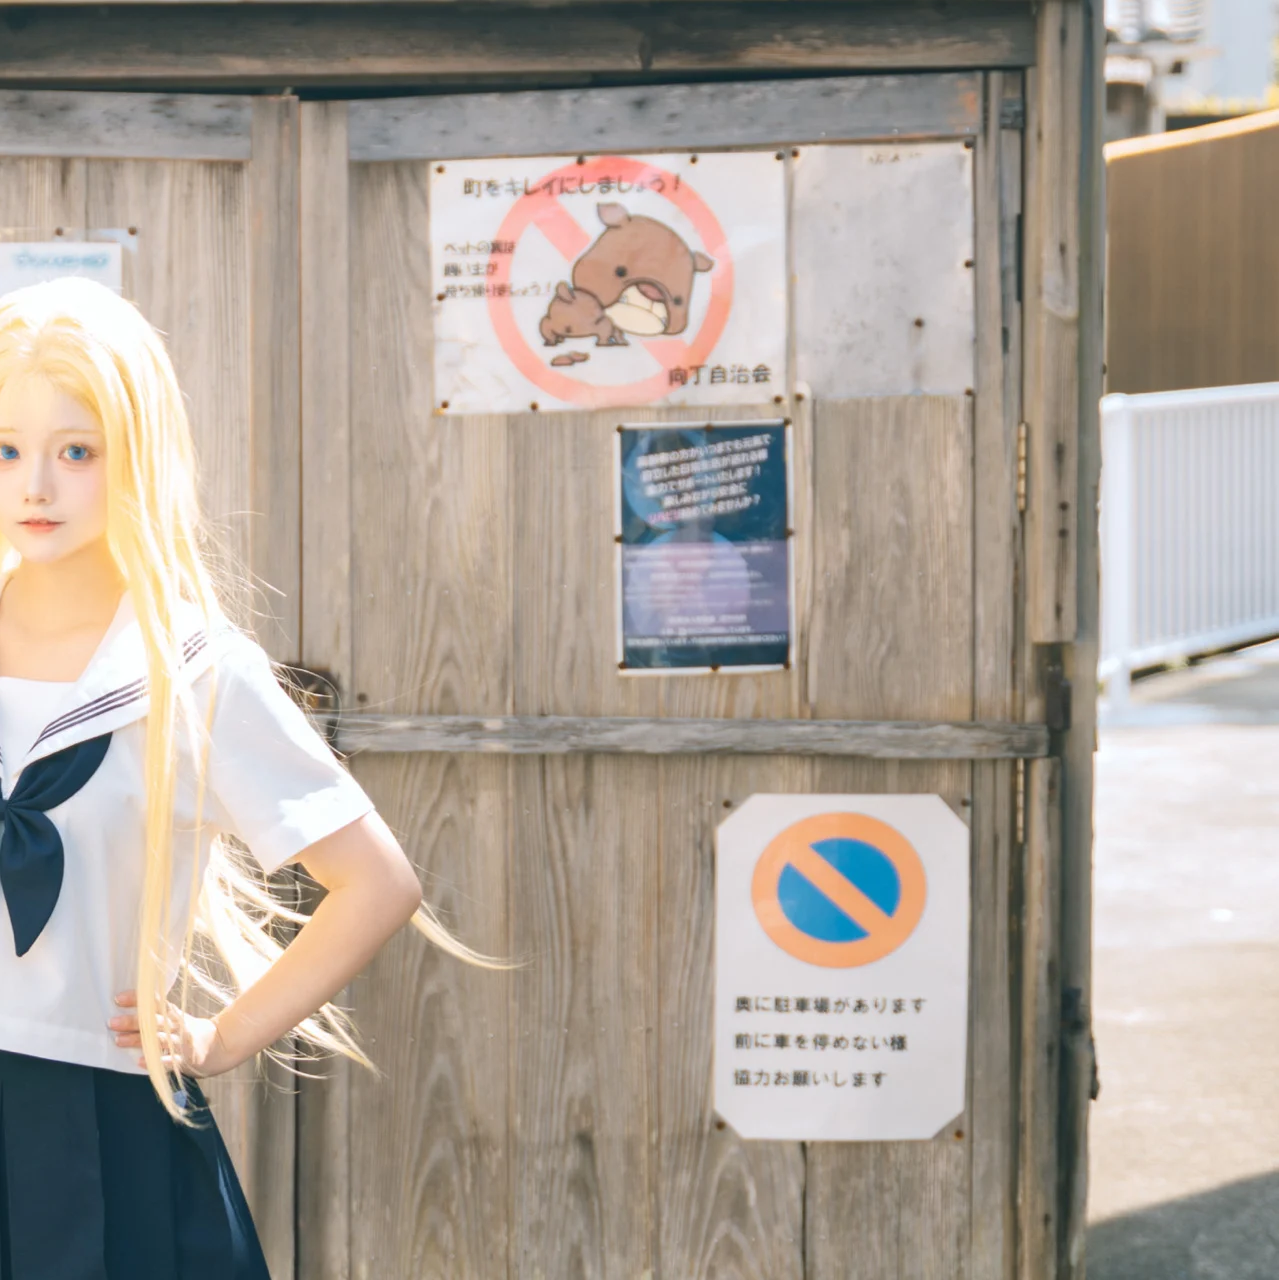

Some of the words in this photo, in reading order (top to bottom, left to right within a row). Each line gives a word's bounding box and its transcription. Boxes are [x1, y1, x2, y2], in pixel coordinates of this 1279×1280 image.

[734, 995, 927, 1014] 奥に駐車場があります
[734, 1032, 908, 1051] 前に車を停めない様
[733, 1068, 888, 1087] 協力お願いします
